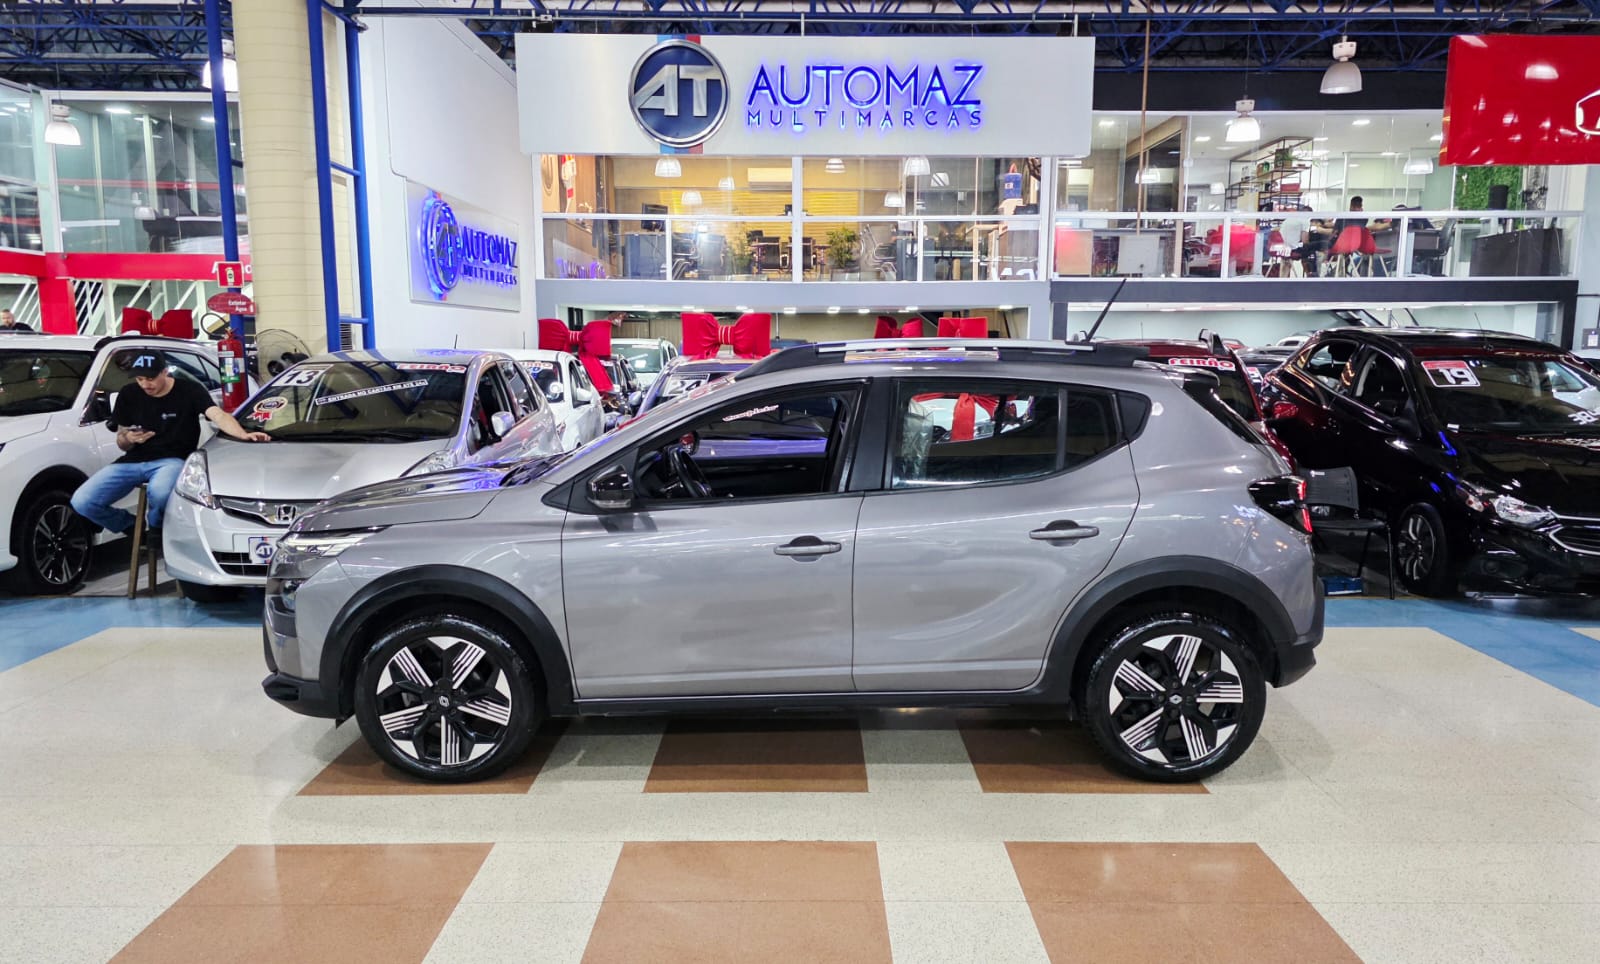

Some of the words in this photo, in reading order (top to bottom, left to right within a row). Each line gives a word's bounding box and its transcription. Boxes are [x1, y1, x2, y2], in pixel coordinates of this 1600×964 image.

[632, 64, 723, 118] AT
[747, 63, 984, 107] AUTOMAZ
[747, 110, 983, 126] MULTIMARCAS
[462, 225, 519, 269] AUTOMAZ
[132, 355, 156, 368] AT
[1168, 358, 1235, 369] FEIRÃO
[284, 369, 319, 385] 13
[1438, 367, 1478, 385] 19
